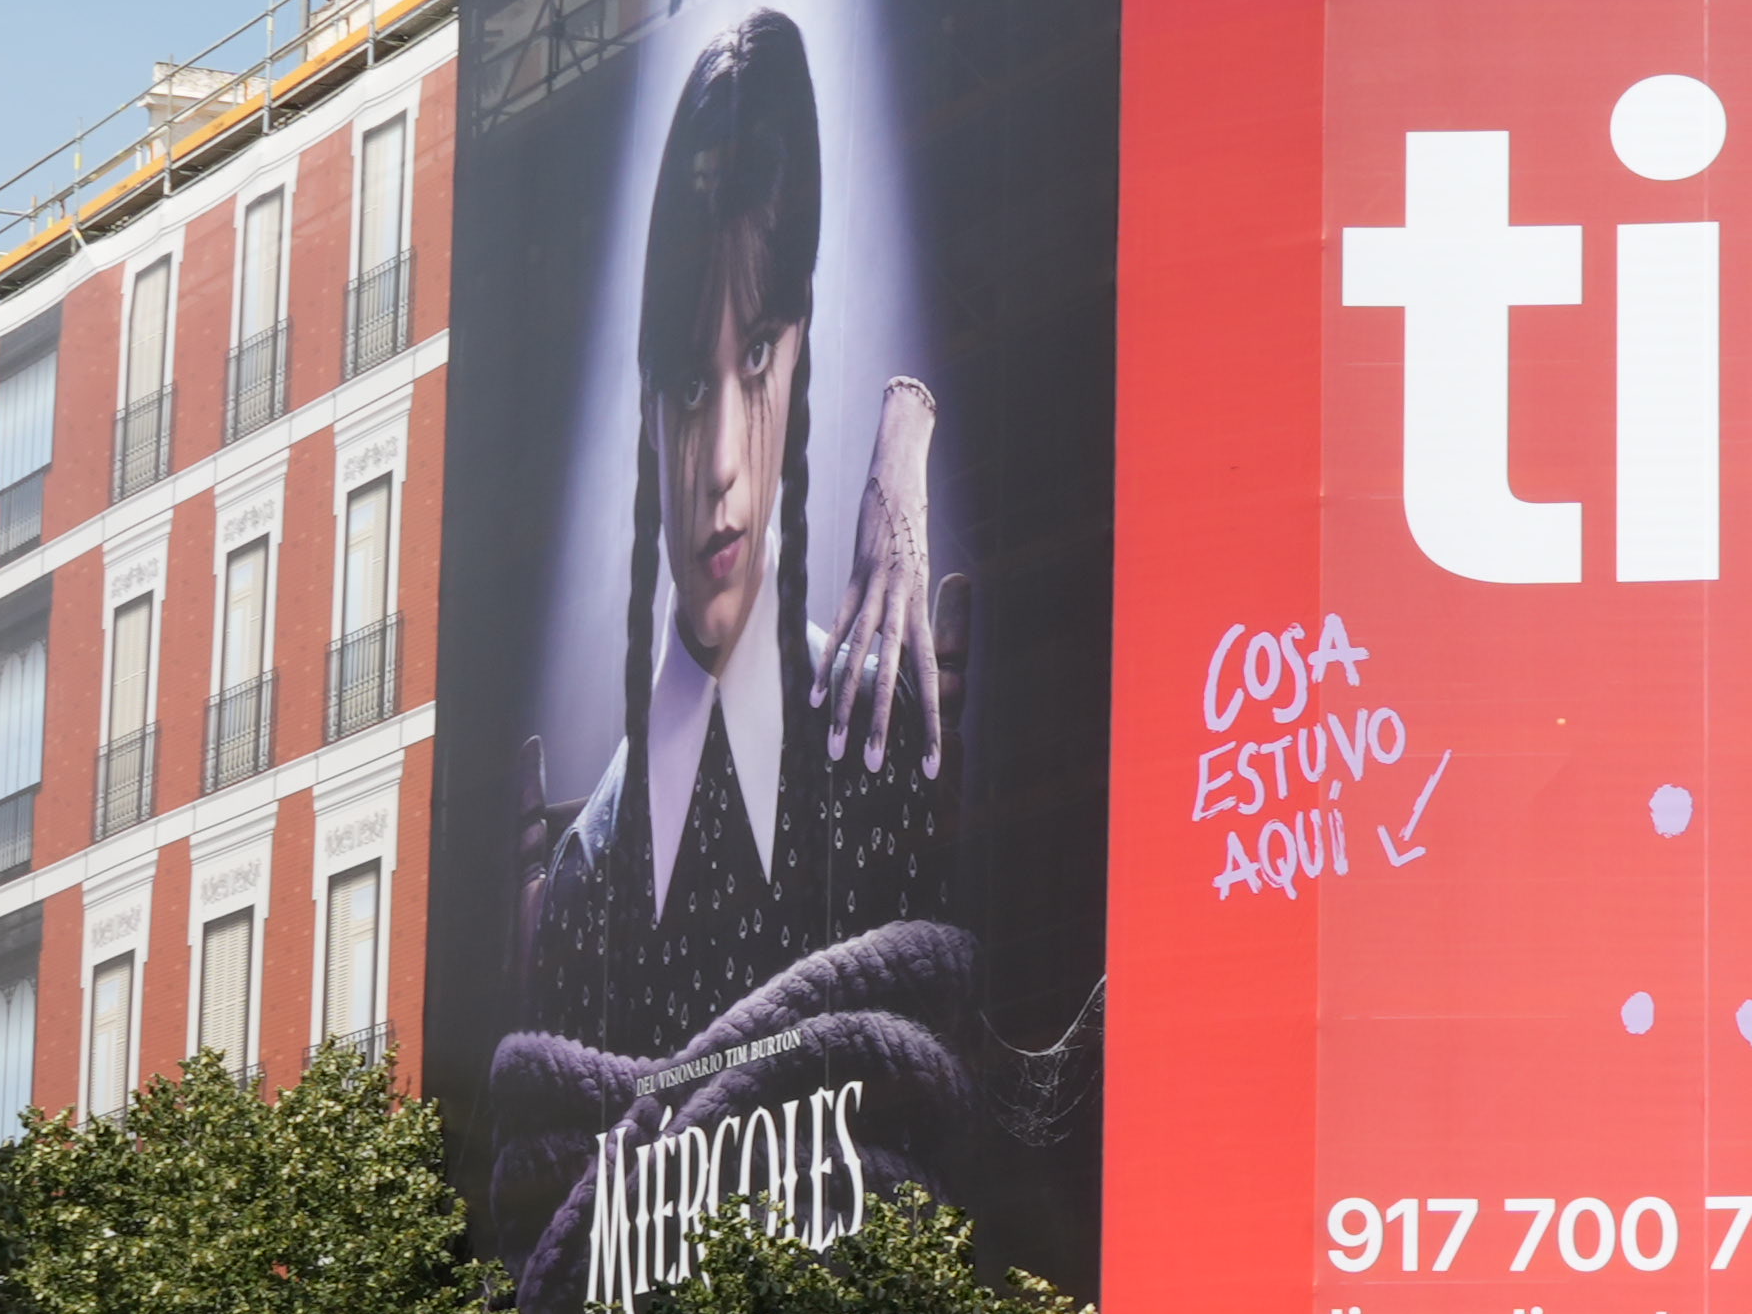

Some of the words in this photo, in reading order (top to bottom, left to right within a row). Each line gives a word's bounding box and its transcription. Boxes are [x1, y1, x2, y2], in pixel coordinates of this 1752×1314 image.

[1203, 613, 1369, 732] COSA
[1192, 707, 1406, 821] ESTUVO
[1212, 779, 1348, 899] AQUÍ
[636, 1074, 657, 1097] DEL
[658, 1052, 723, 1090] VISIONARIO
[724, 1044, 748, 1069] TIM
[750, 1028, 802, 1061] BURTON
[1326, 1197, 1479, 1273] 917
[1503, 1196, 1680, 1273] 700
